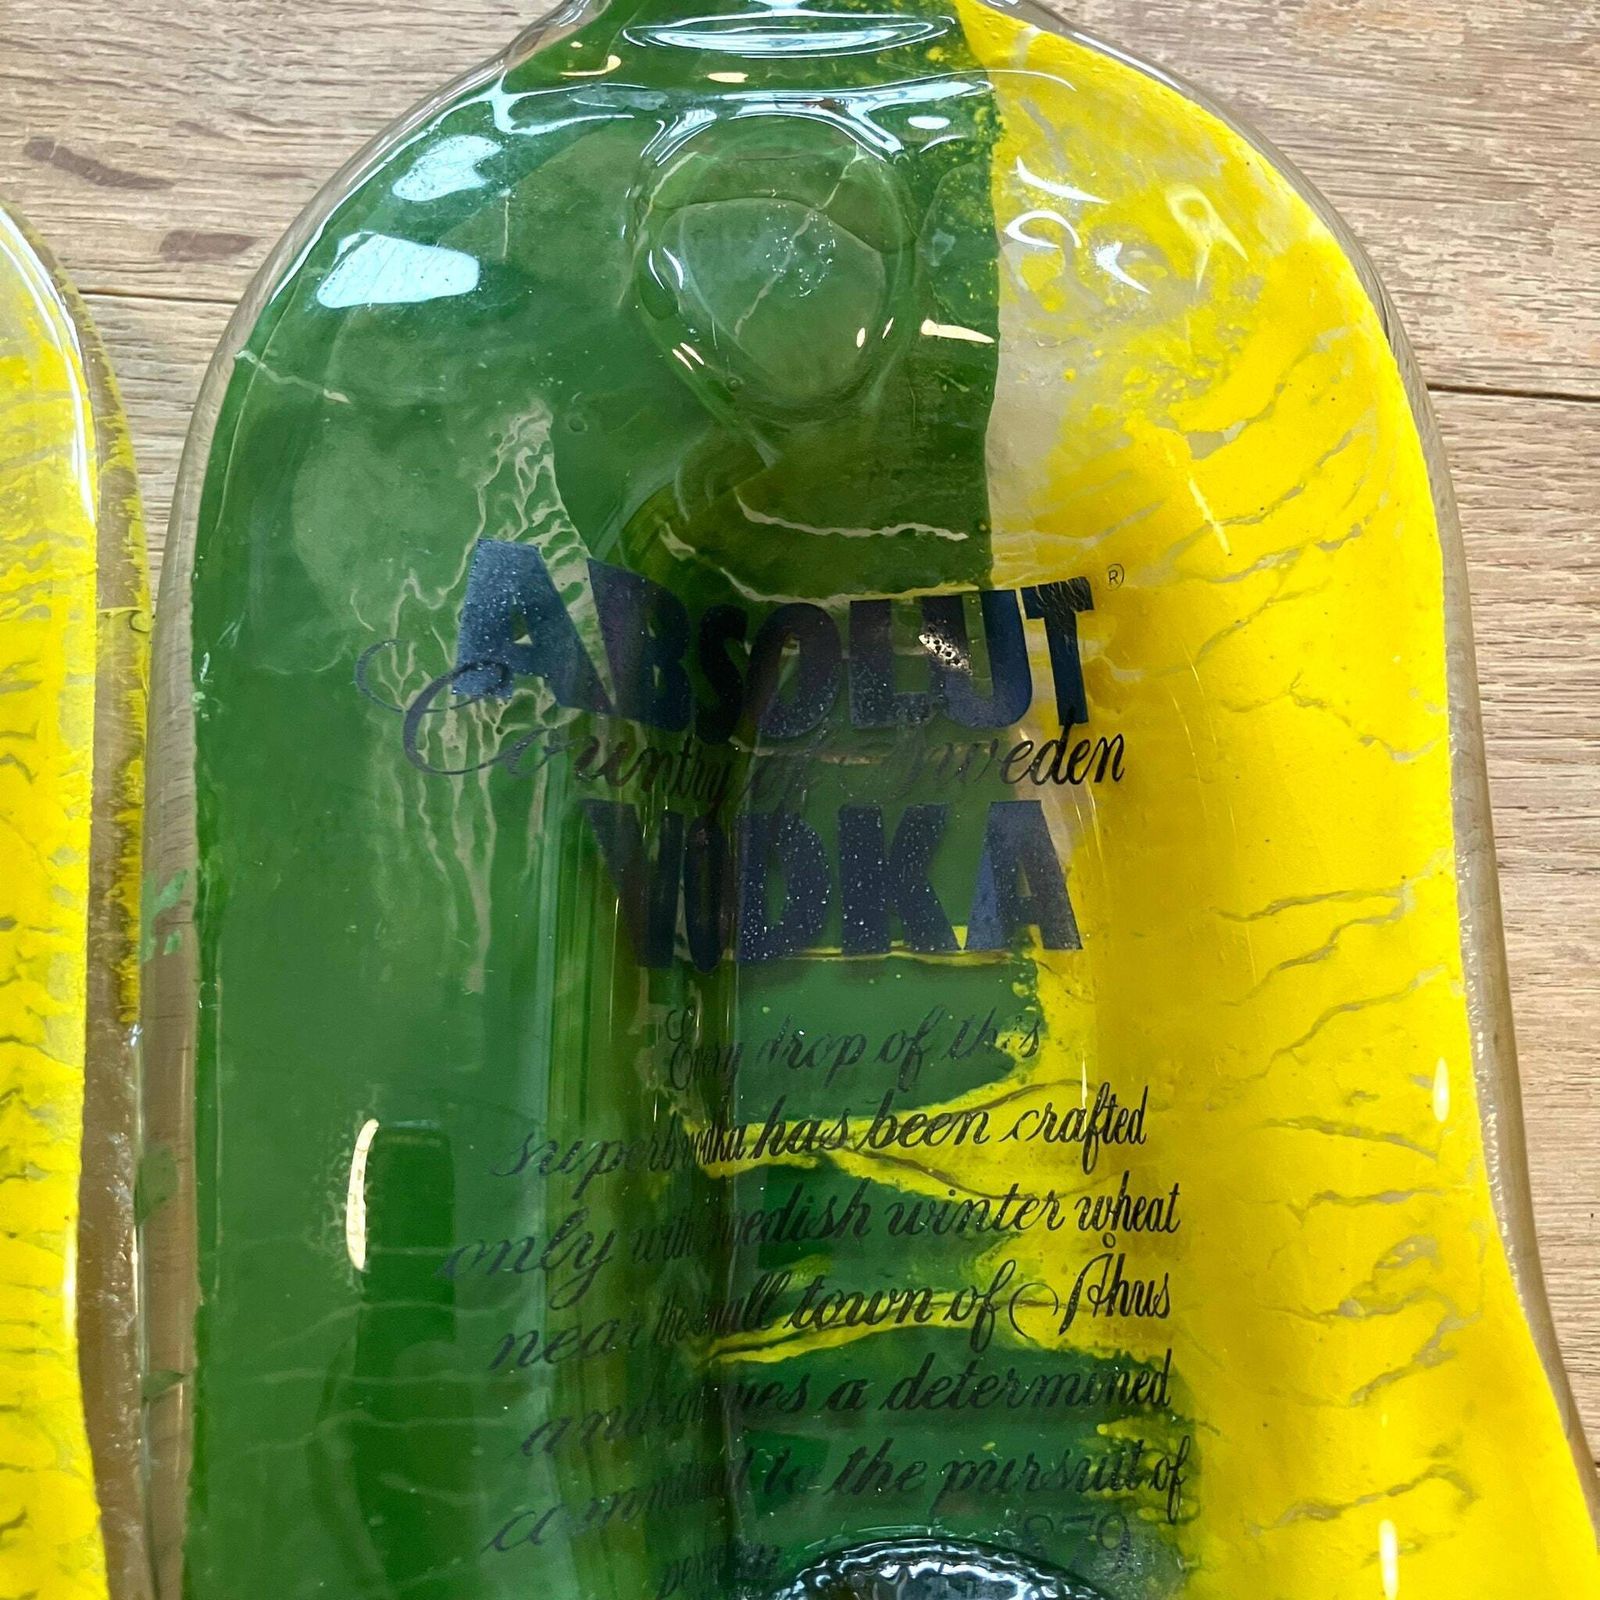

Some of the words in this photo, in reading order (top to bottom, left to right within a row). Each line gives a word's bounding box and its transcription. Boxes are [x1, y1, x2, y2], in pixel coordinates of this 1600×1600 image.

[449, 537, 1095, 744] ABSOLUT
[585, 799, 1083, 973] VODKA
[874, 1004, 948, 1092] of
[752, 1094, 852, 1161] has
[852, 1089, 991, 1152] been
[998, 1081, 1150, 1175] crafted
[438, 1206, 620, 1311] only
[884, 1182, 1065, 1235] winter
[1074, 1170, 1182, 1234] wheat
[783, 1274, 932, 1333] town
[942, 1259, 1017, 1353] of
[1009, 1232, 1171, 1338] Åhus
[820, 1376, 869, 1412] a
[878, 1347, 1173, 1412] determined
[823, 1437, 930, 1498] the
[928, 1436, 1146, 1520] pursuit
[1148, 1434, 1192, 1525] of
